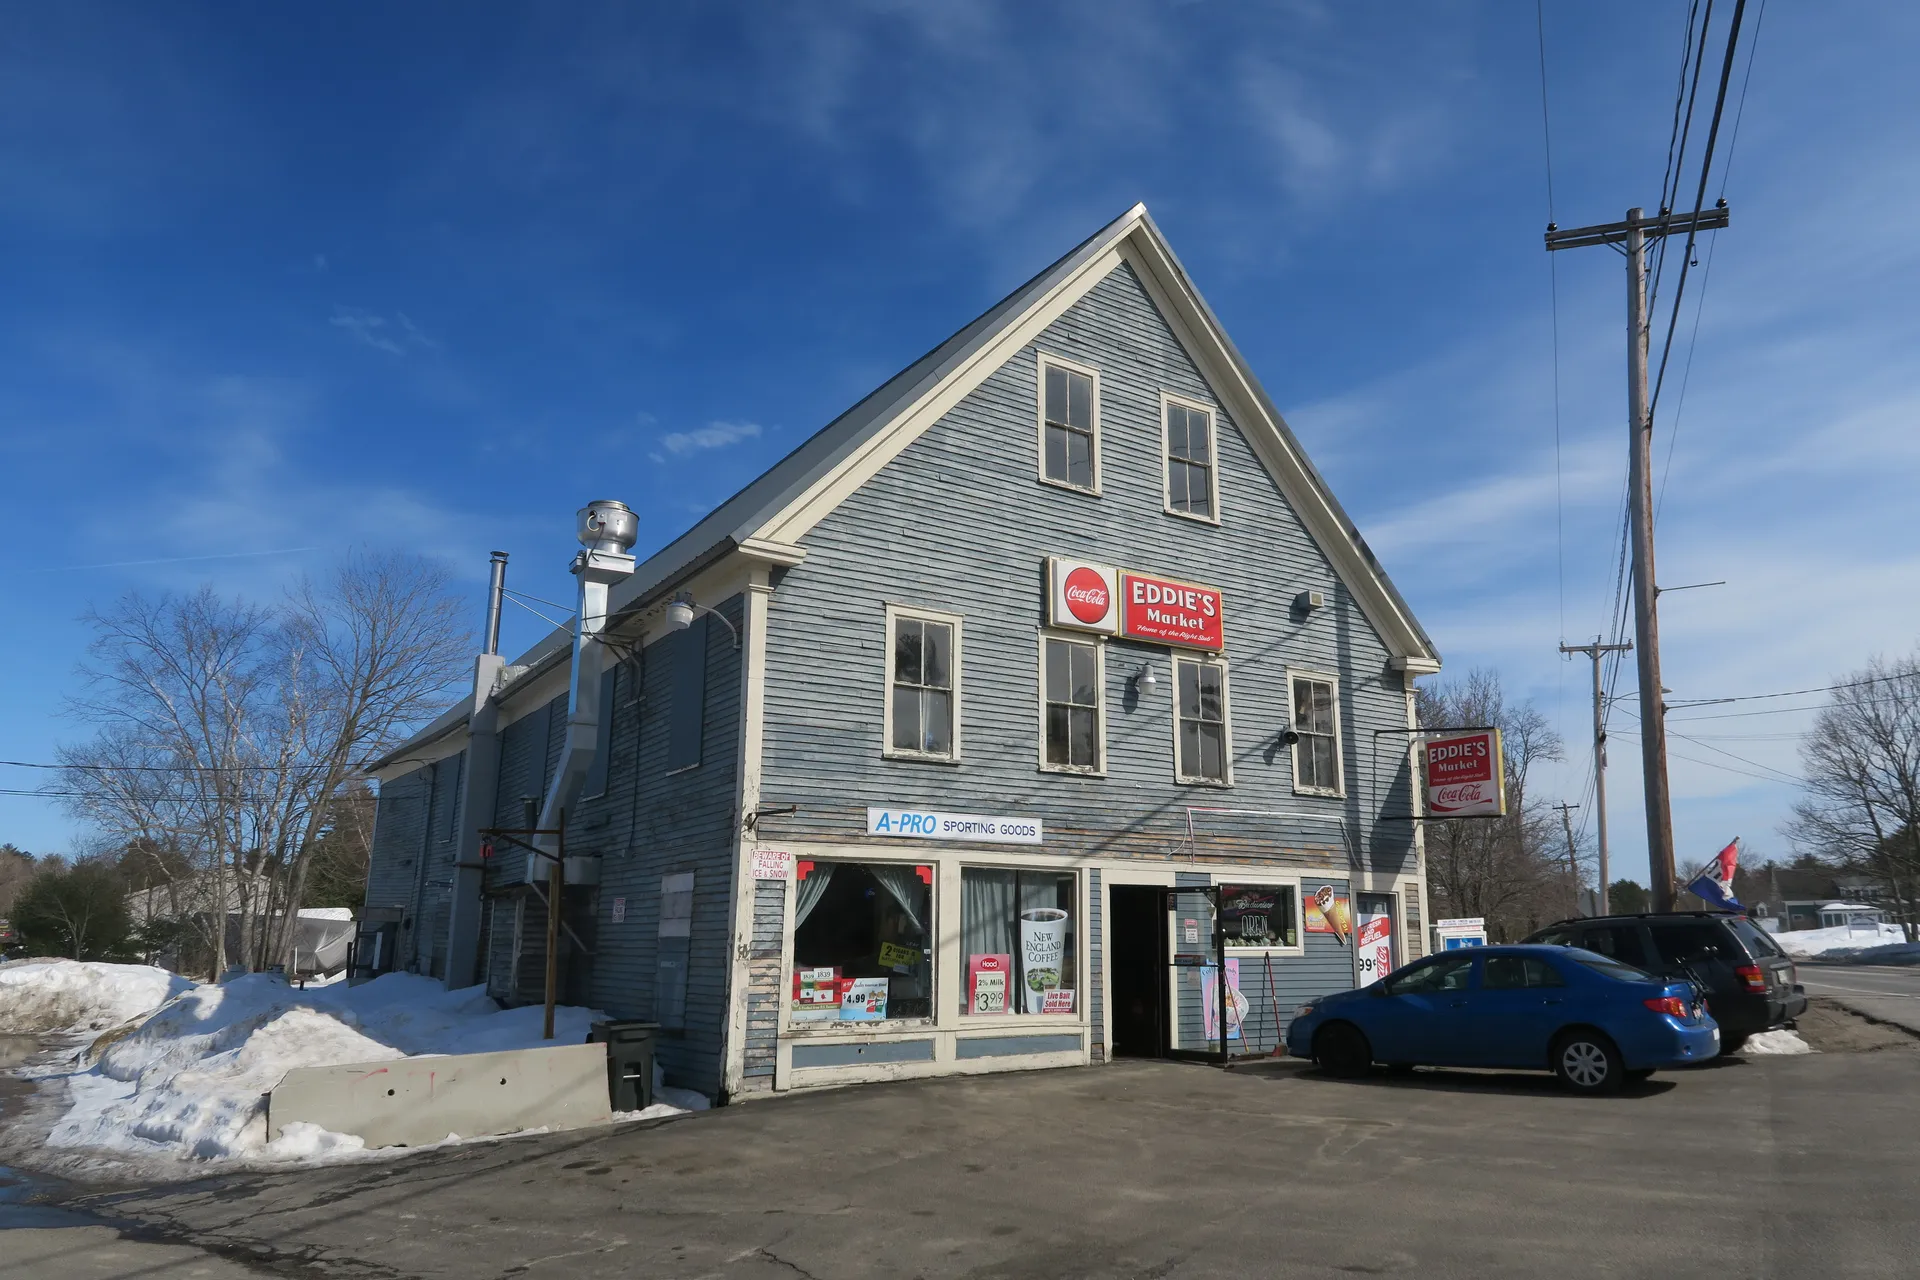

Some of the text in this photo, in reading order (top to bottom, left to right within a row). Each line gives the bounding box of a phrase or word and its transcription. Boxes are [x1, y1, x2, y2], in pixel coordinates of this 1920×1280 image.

[1067, 585, 1106, 605] Coca-Cola
[1133, 581, 1215, 617] EDDIE'S
[1147, 608, 1204, 630] Market
[1179, 631, 1197, 640] Right
[1429, 741, 1486, 764] EDDIE'S
[1438, 760, 1478, 772] Market
[1438, 783, 1482, 803] Coca-Cola
[875, 812, 1036, 836] A-PRO SPORTING GOODS
[753, 851, 780, 860] BEWARE
[758, 860, 783, 869] FALLING
[769, 870, 788, 878] SNOW
[1361, 931, 1382, 945] REFUEL
[1026, 941, 1061, 952] ENGLAND
[1028, 952, 1058, 962] COFFEE
[982, 960, 998, 968] Hood
[843, 993, 865, 1003] $4.99
[1047, 992, 1058, 1000] Live
